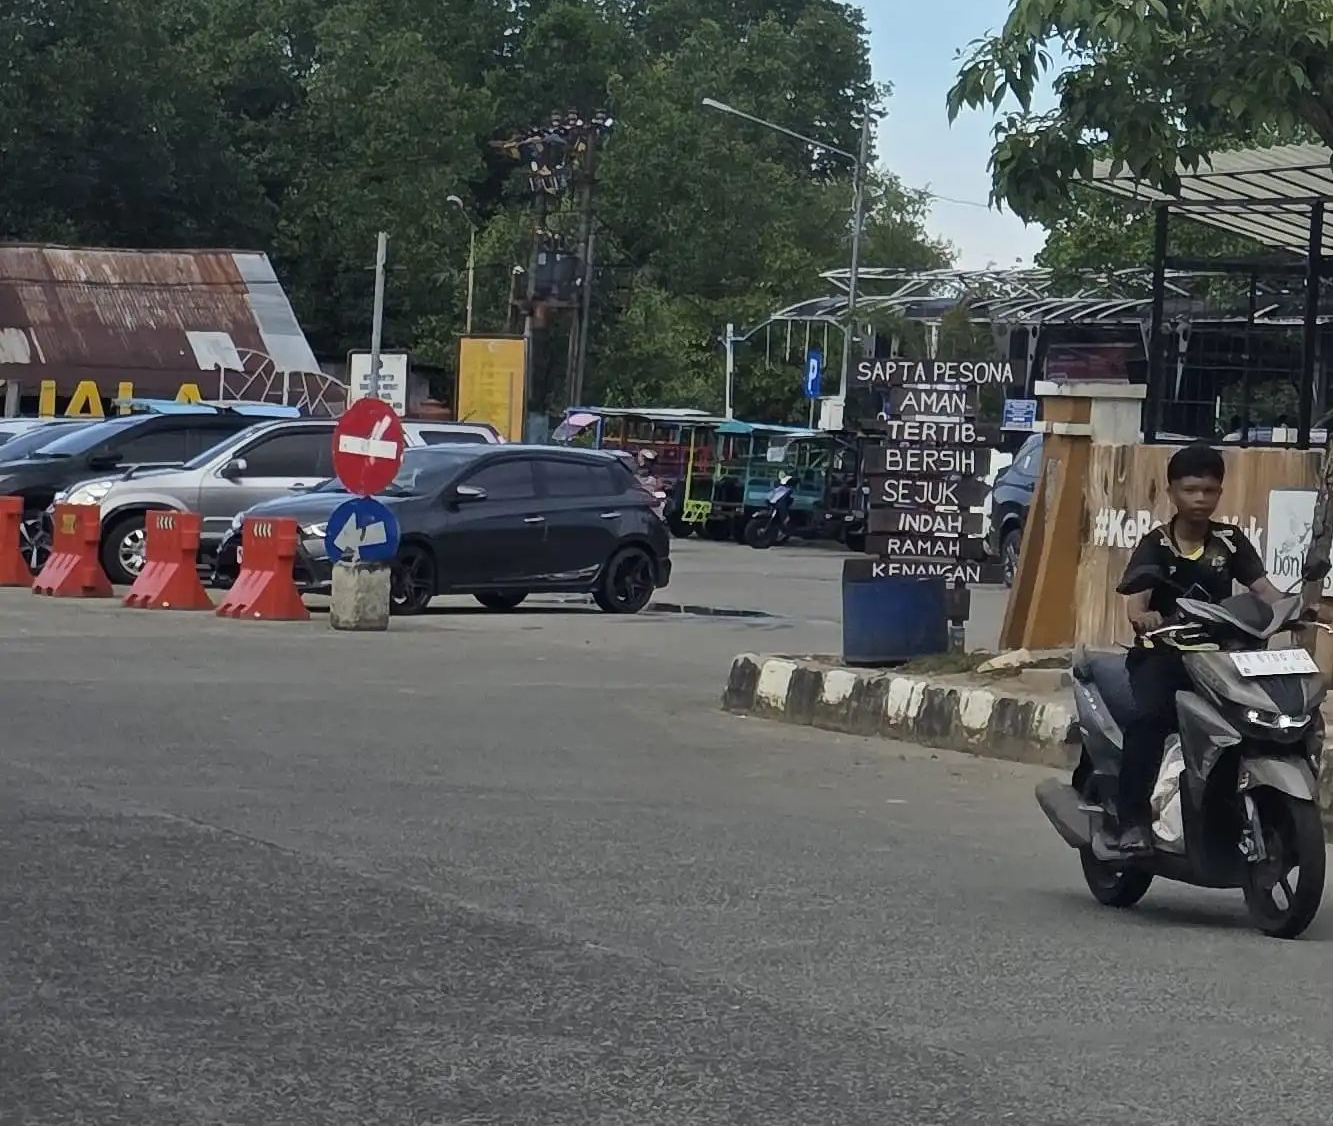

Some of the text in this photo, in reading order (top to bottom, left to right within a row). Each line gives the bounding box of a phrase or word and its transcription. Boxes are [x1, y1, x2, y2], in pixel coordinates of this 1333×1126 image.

[808, 358, 818, 392] P
[857, 361, 1014, 384] SAPTA PESONA
[885, 449, 975, 473] BERSIH
[882, 480, 959, 505] SEJUK
[898, 512, 963, 534] INDAH
[887, 538, 960, 556] RAMAH
[872, 562, 981, 582] KENANGAN
